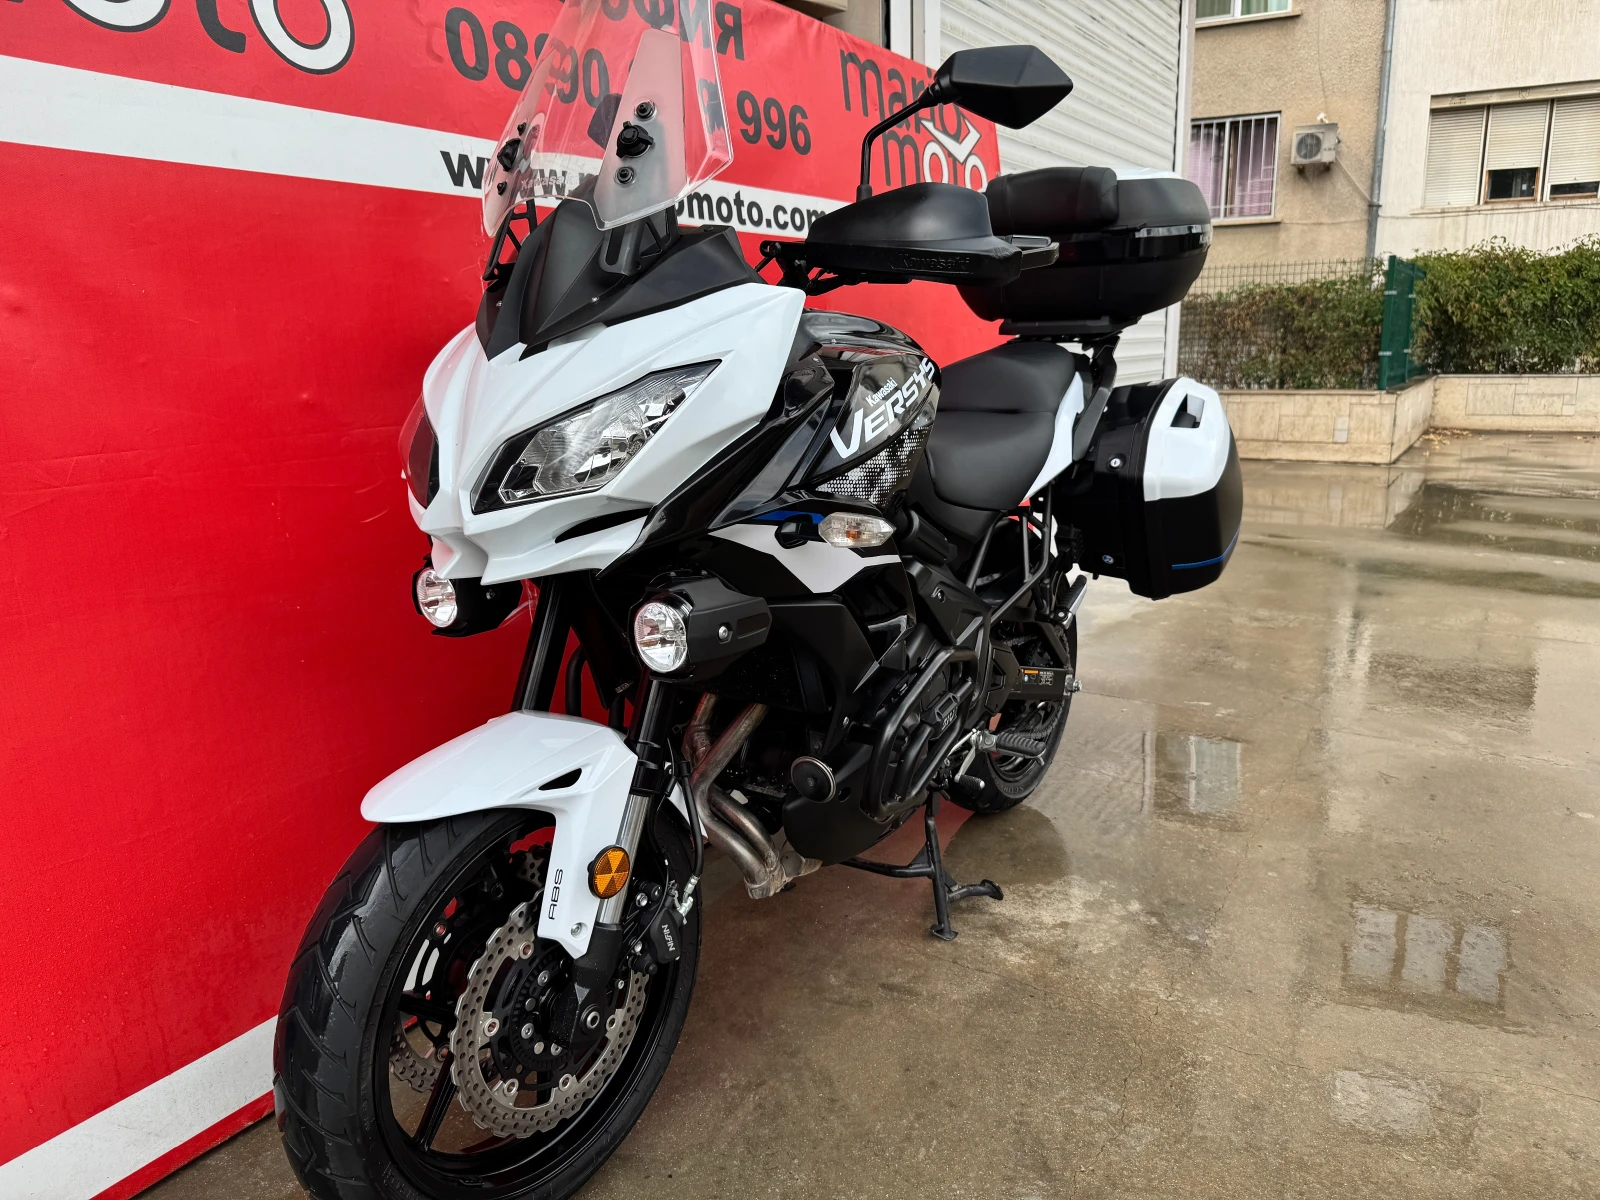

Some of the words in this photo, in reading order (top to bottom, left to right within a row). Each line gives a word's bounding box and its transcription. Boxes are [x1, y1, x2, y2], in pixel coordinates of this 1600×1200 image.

[736, 90, 812, 156] 996
[829, 357, 935, 459] VERSYS
[865, 376, 898, 407] Kawasaki
[548, 868, 563, 920] ABS
